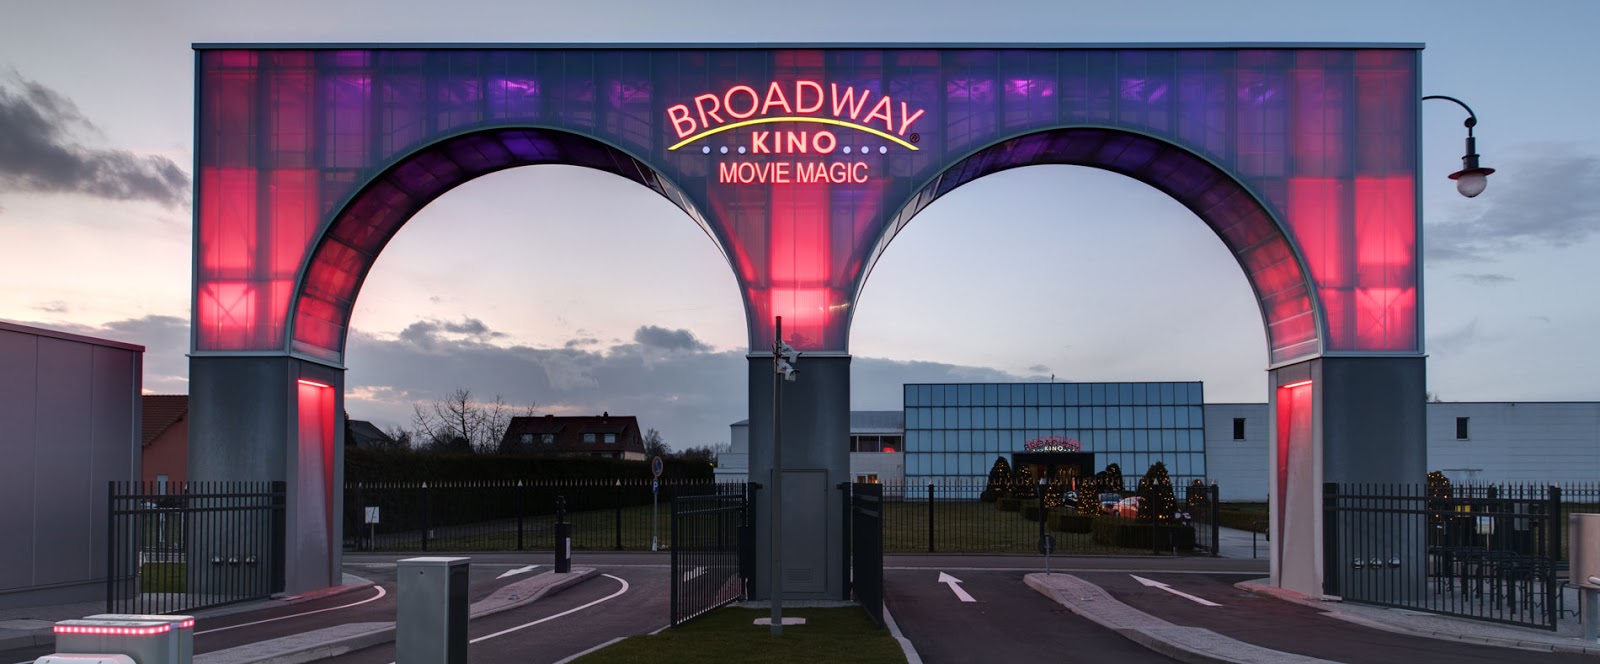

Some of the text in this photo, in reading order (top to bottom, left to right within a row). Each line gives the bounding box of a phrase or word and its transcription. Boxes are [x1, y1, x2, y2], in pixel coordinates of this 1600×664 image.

[667, 80, 924, 138] BROADWAY
[752, 131, 836, 154] KINO
[719, 162, 868, 183] MOVIE MAGIC
